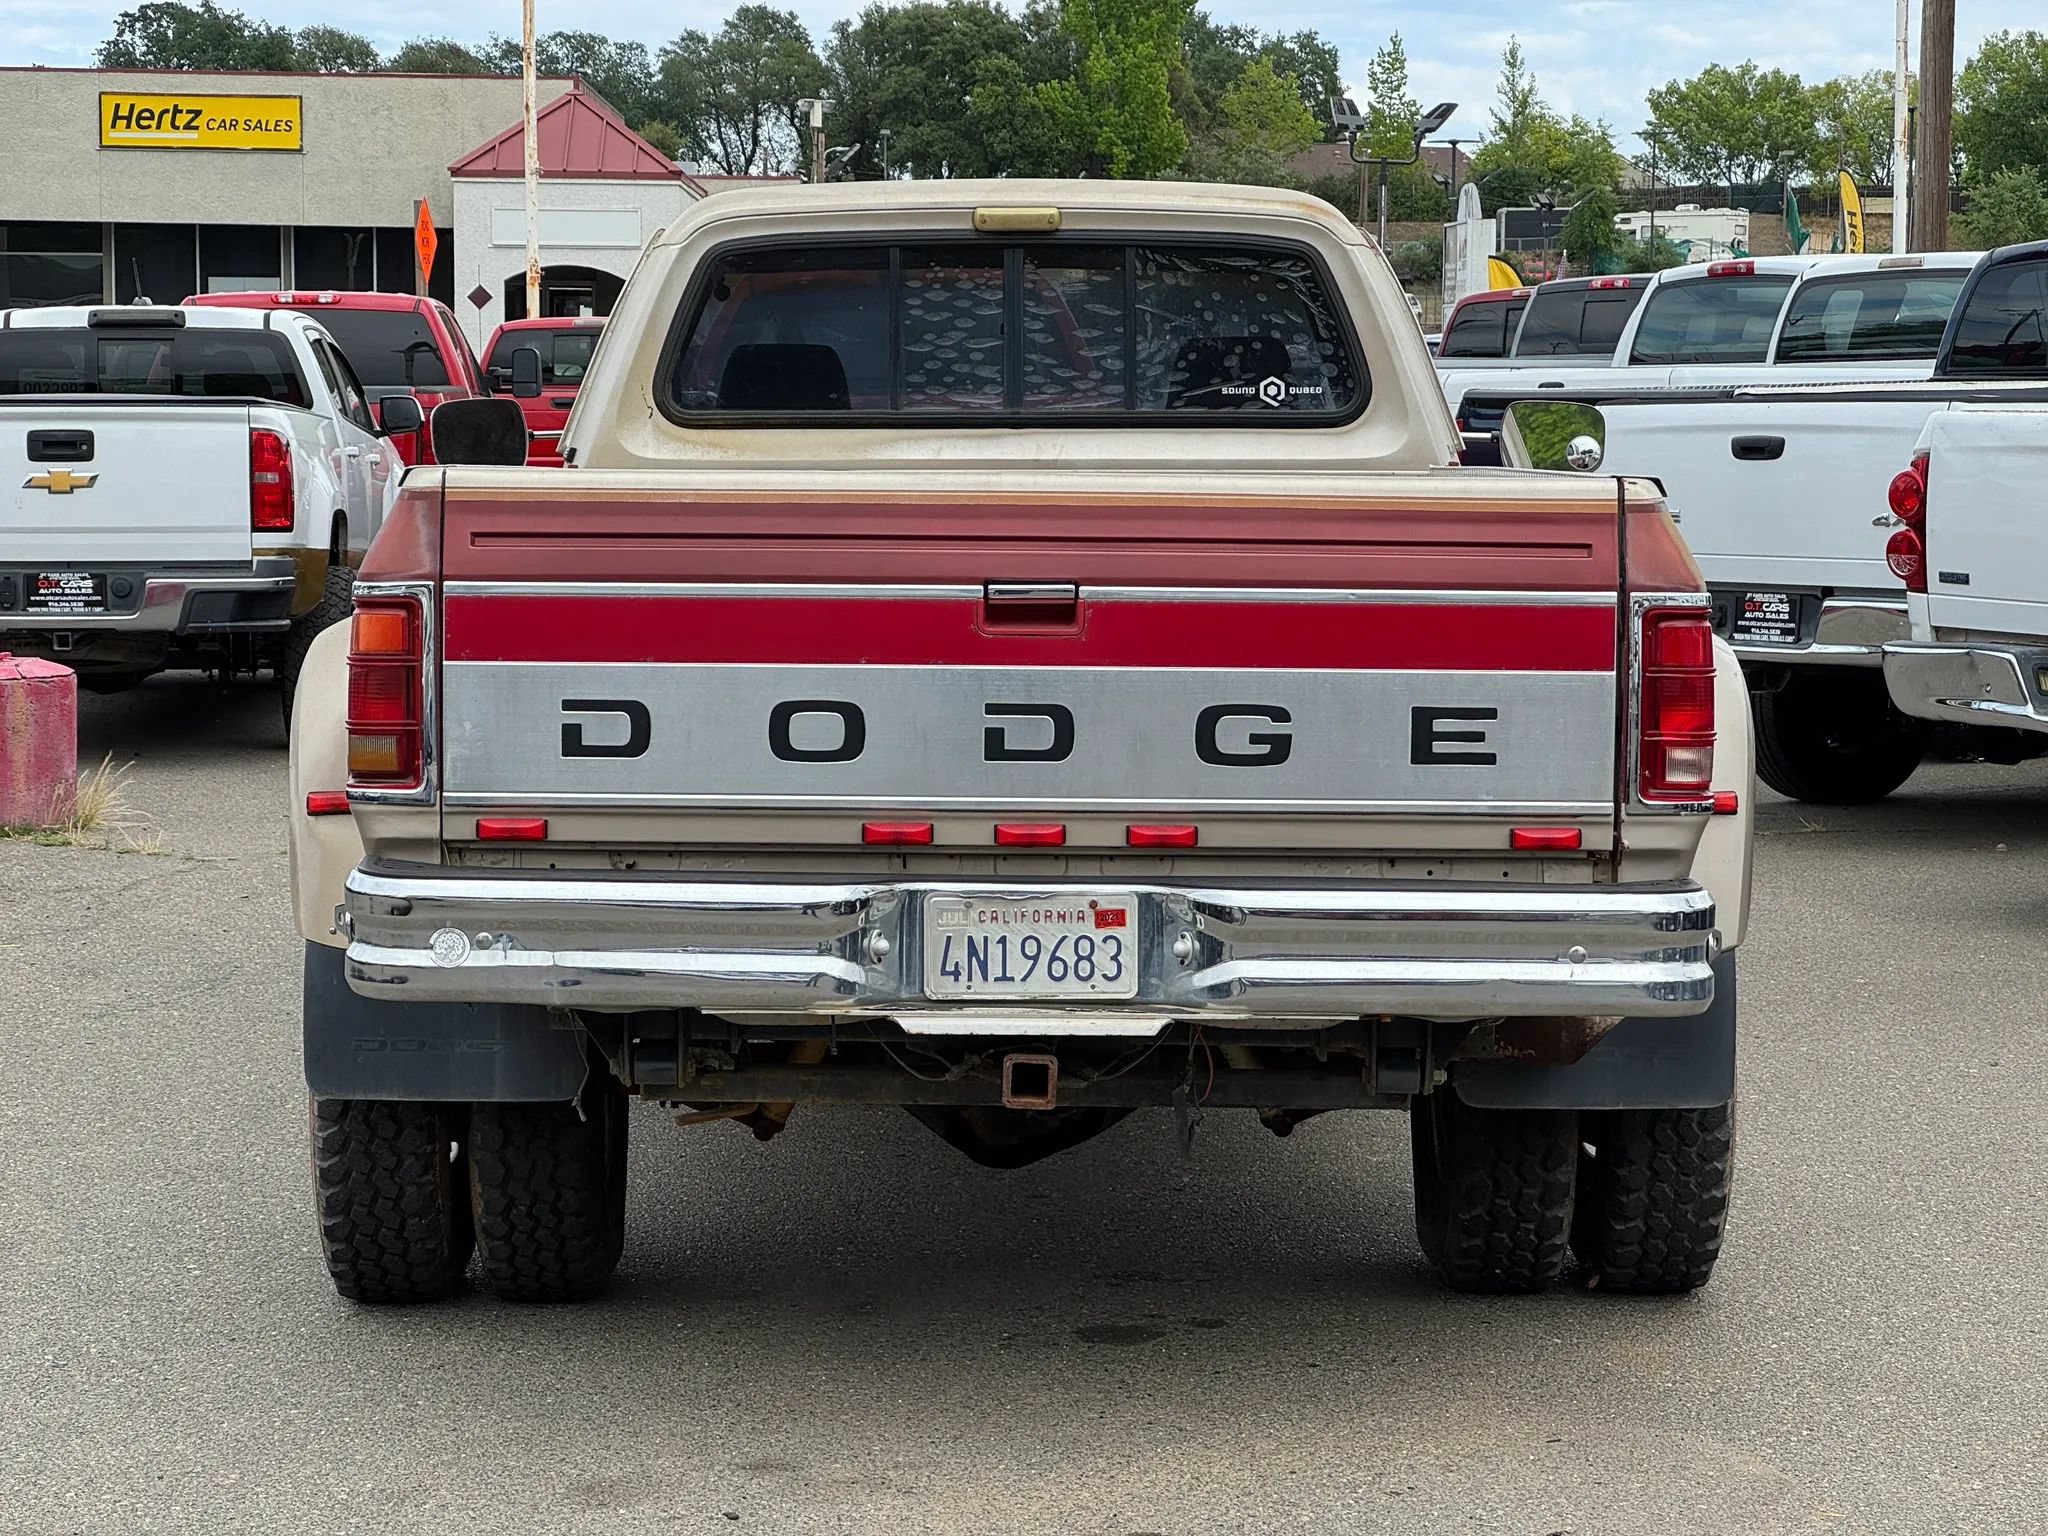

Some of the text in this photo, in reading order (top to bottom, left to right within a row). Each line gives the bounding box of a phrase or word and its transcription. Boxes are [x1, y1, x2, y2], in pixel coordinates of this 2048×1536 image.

[110, 103, 294, 132] Hertz CAR SALES
[1221, 386, 1323, 395] SOUND QUBED
[561, 699, 1498, 767] DODGE
[978, 908, 1086, 924] CALIFORNIA
[940, 934, 1122, 982] 4N19683
